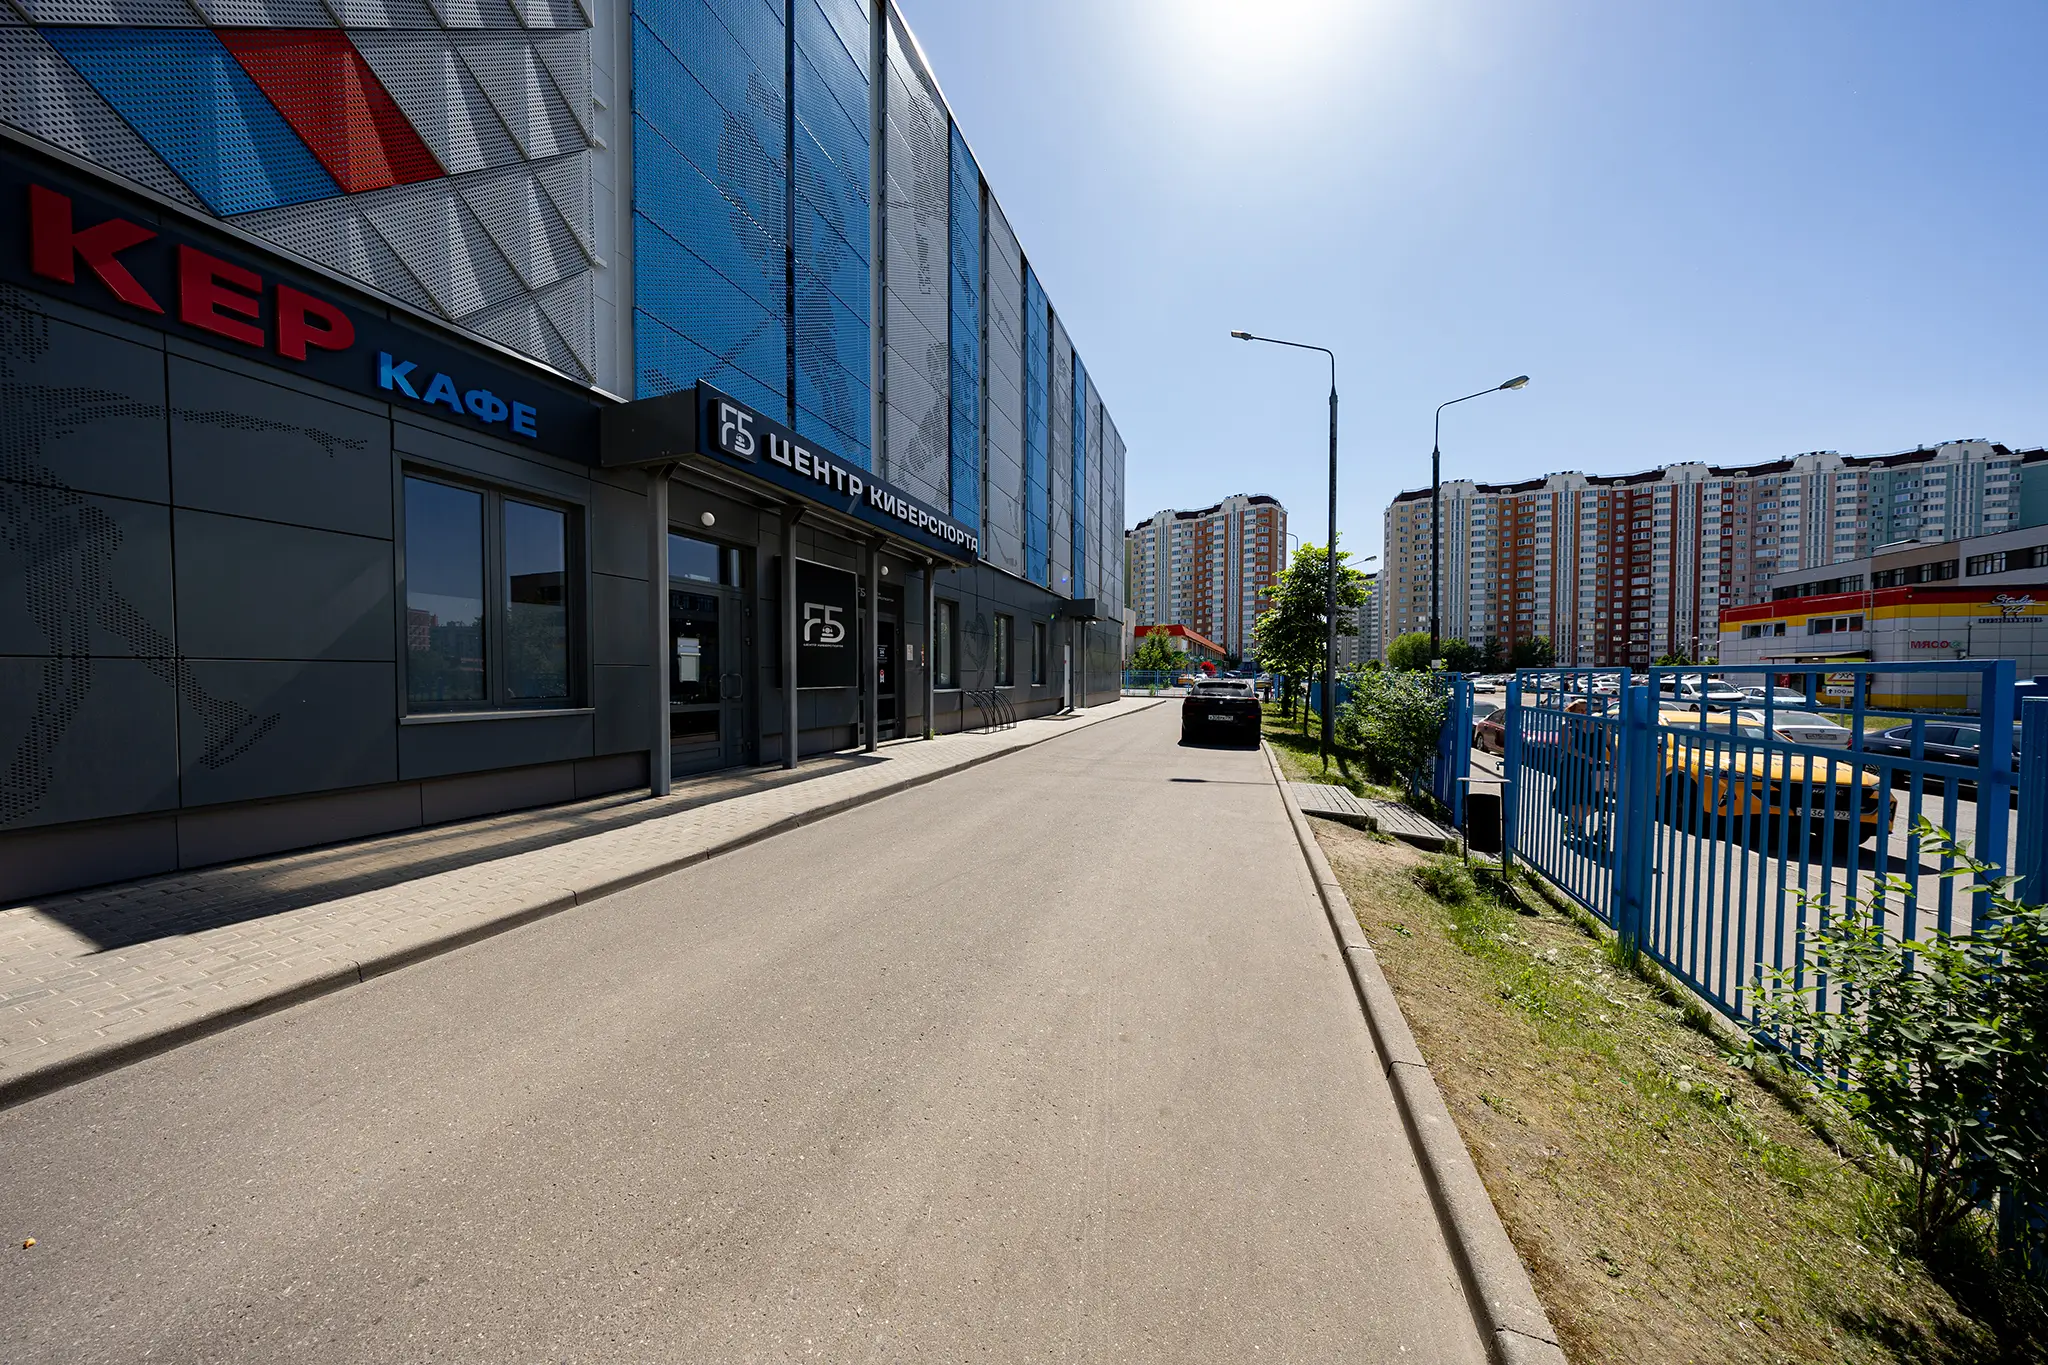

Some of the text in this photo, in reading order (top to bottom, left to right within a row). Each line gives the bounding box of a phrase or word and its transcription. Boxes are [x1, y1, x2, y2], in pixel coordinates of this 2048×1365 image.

[28, 183, 356, 362] КЕР
[377, 350, 538, 438] КАФЕ
[769, 432, 979, 552] ЦЕНТР КИБЕРСПОРТА
[1910, 640, 1949, 649] МЯСО
